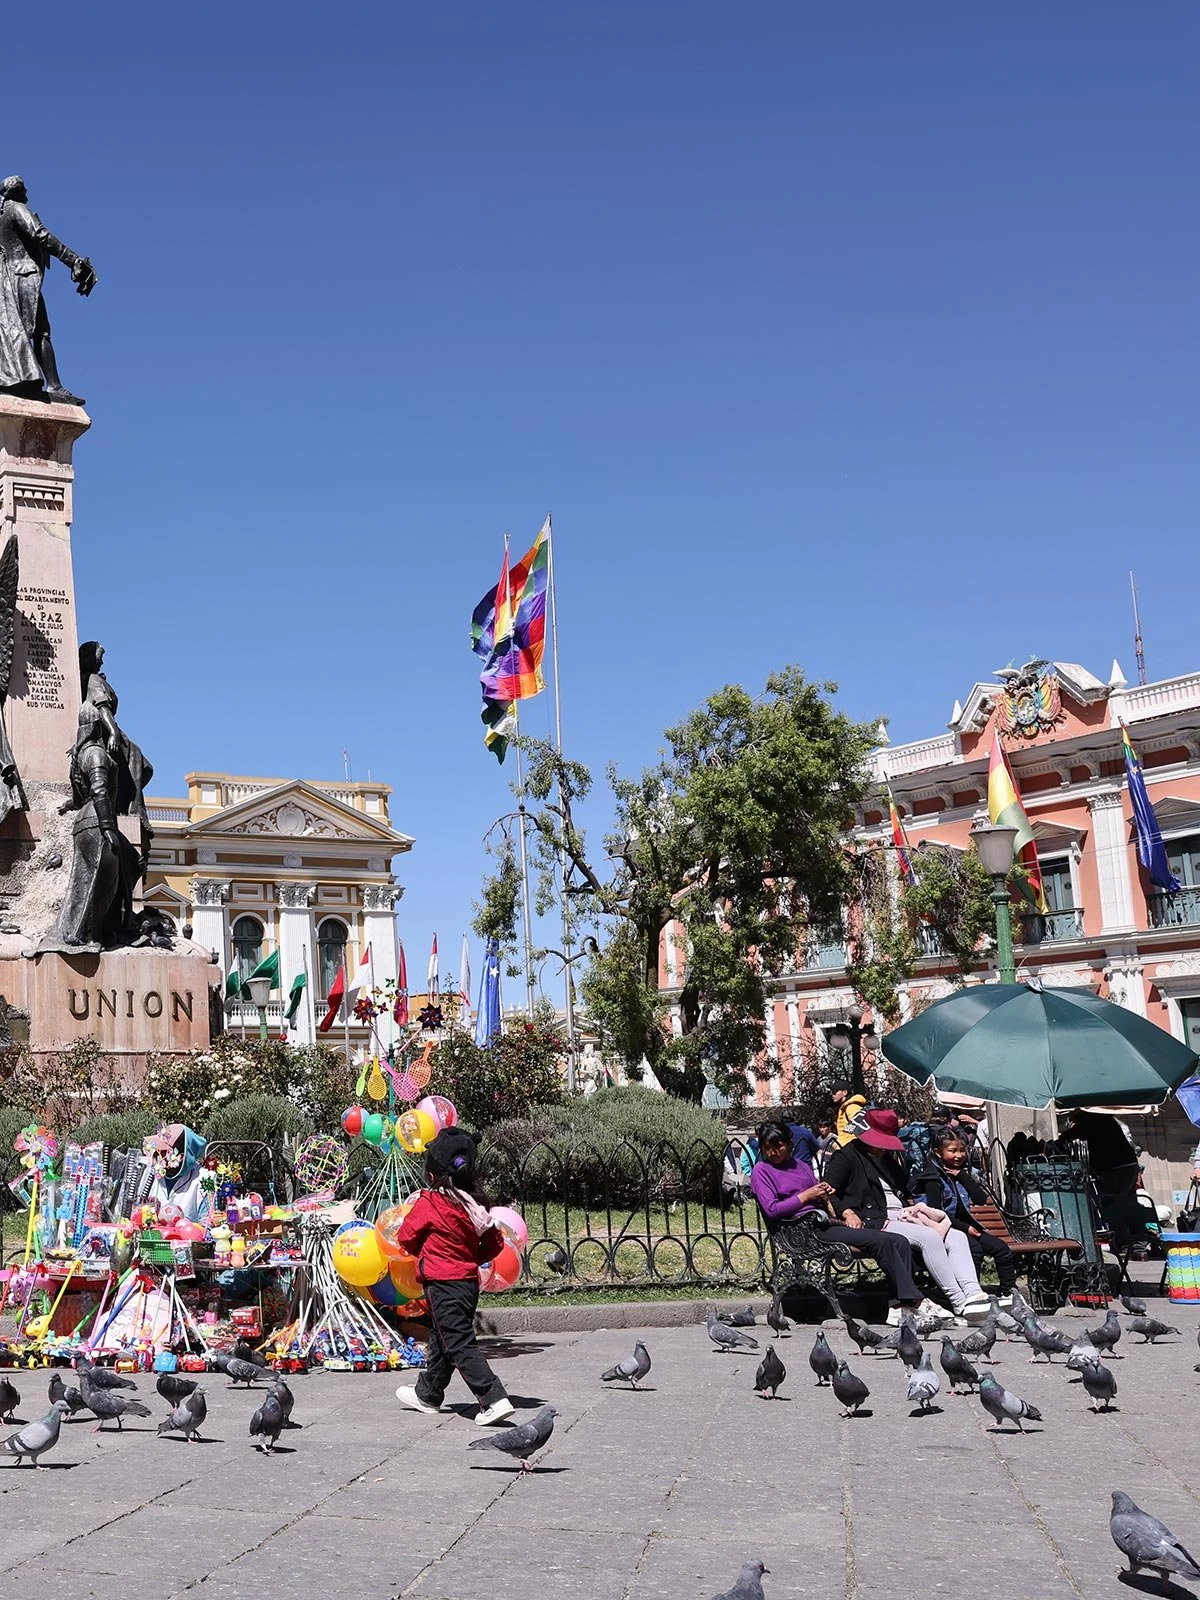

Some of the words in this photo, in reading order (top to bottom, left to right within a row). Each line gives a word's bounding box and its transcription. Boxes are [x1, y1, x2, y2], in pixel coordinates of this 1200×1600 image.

[29, 587, 66, 597] PROVINCIAS
[24, 595, 70, 605] DEPARTAMENTO
[21, 609, 37, 621] LA
[40, 611, 62, 623] PAZ
[47, 622, 64, 631] JULIO
[39, 672, 65, 681] YUNGAS
[31, 687, 59, 695] PACAJES
[30, 694, 60, 702] SICASICA
[39, 702, 65, 710] YUNGAS
[68, 988, 195, 1023] UNION
